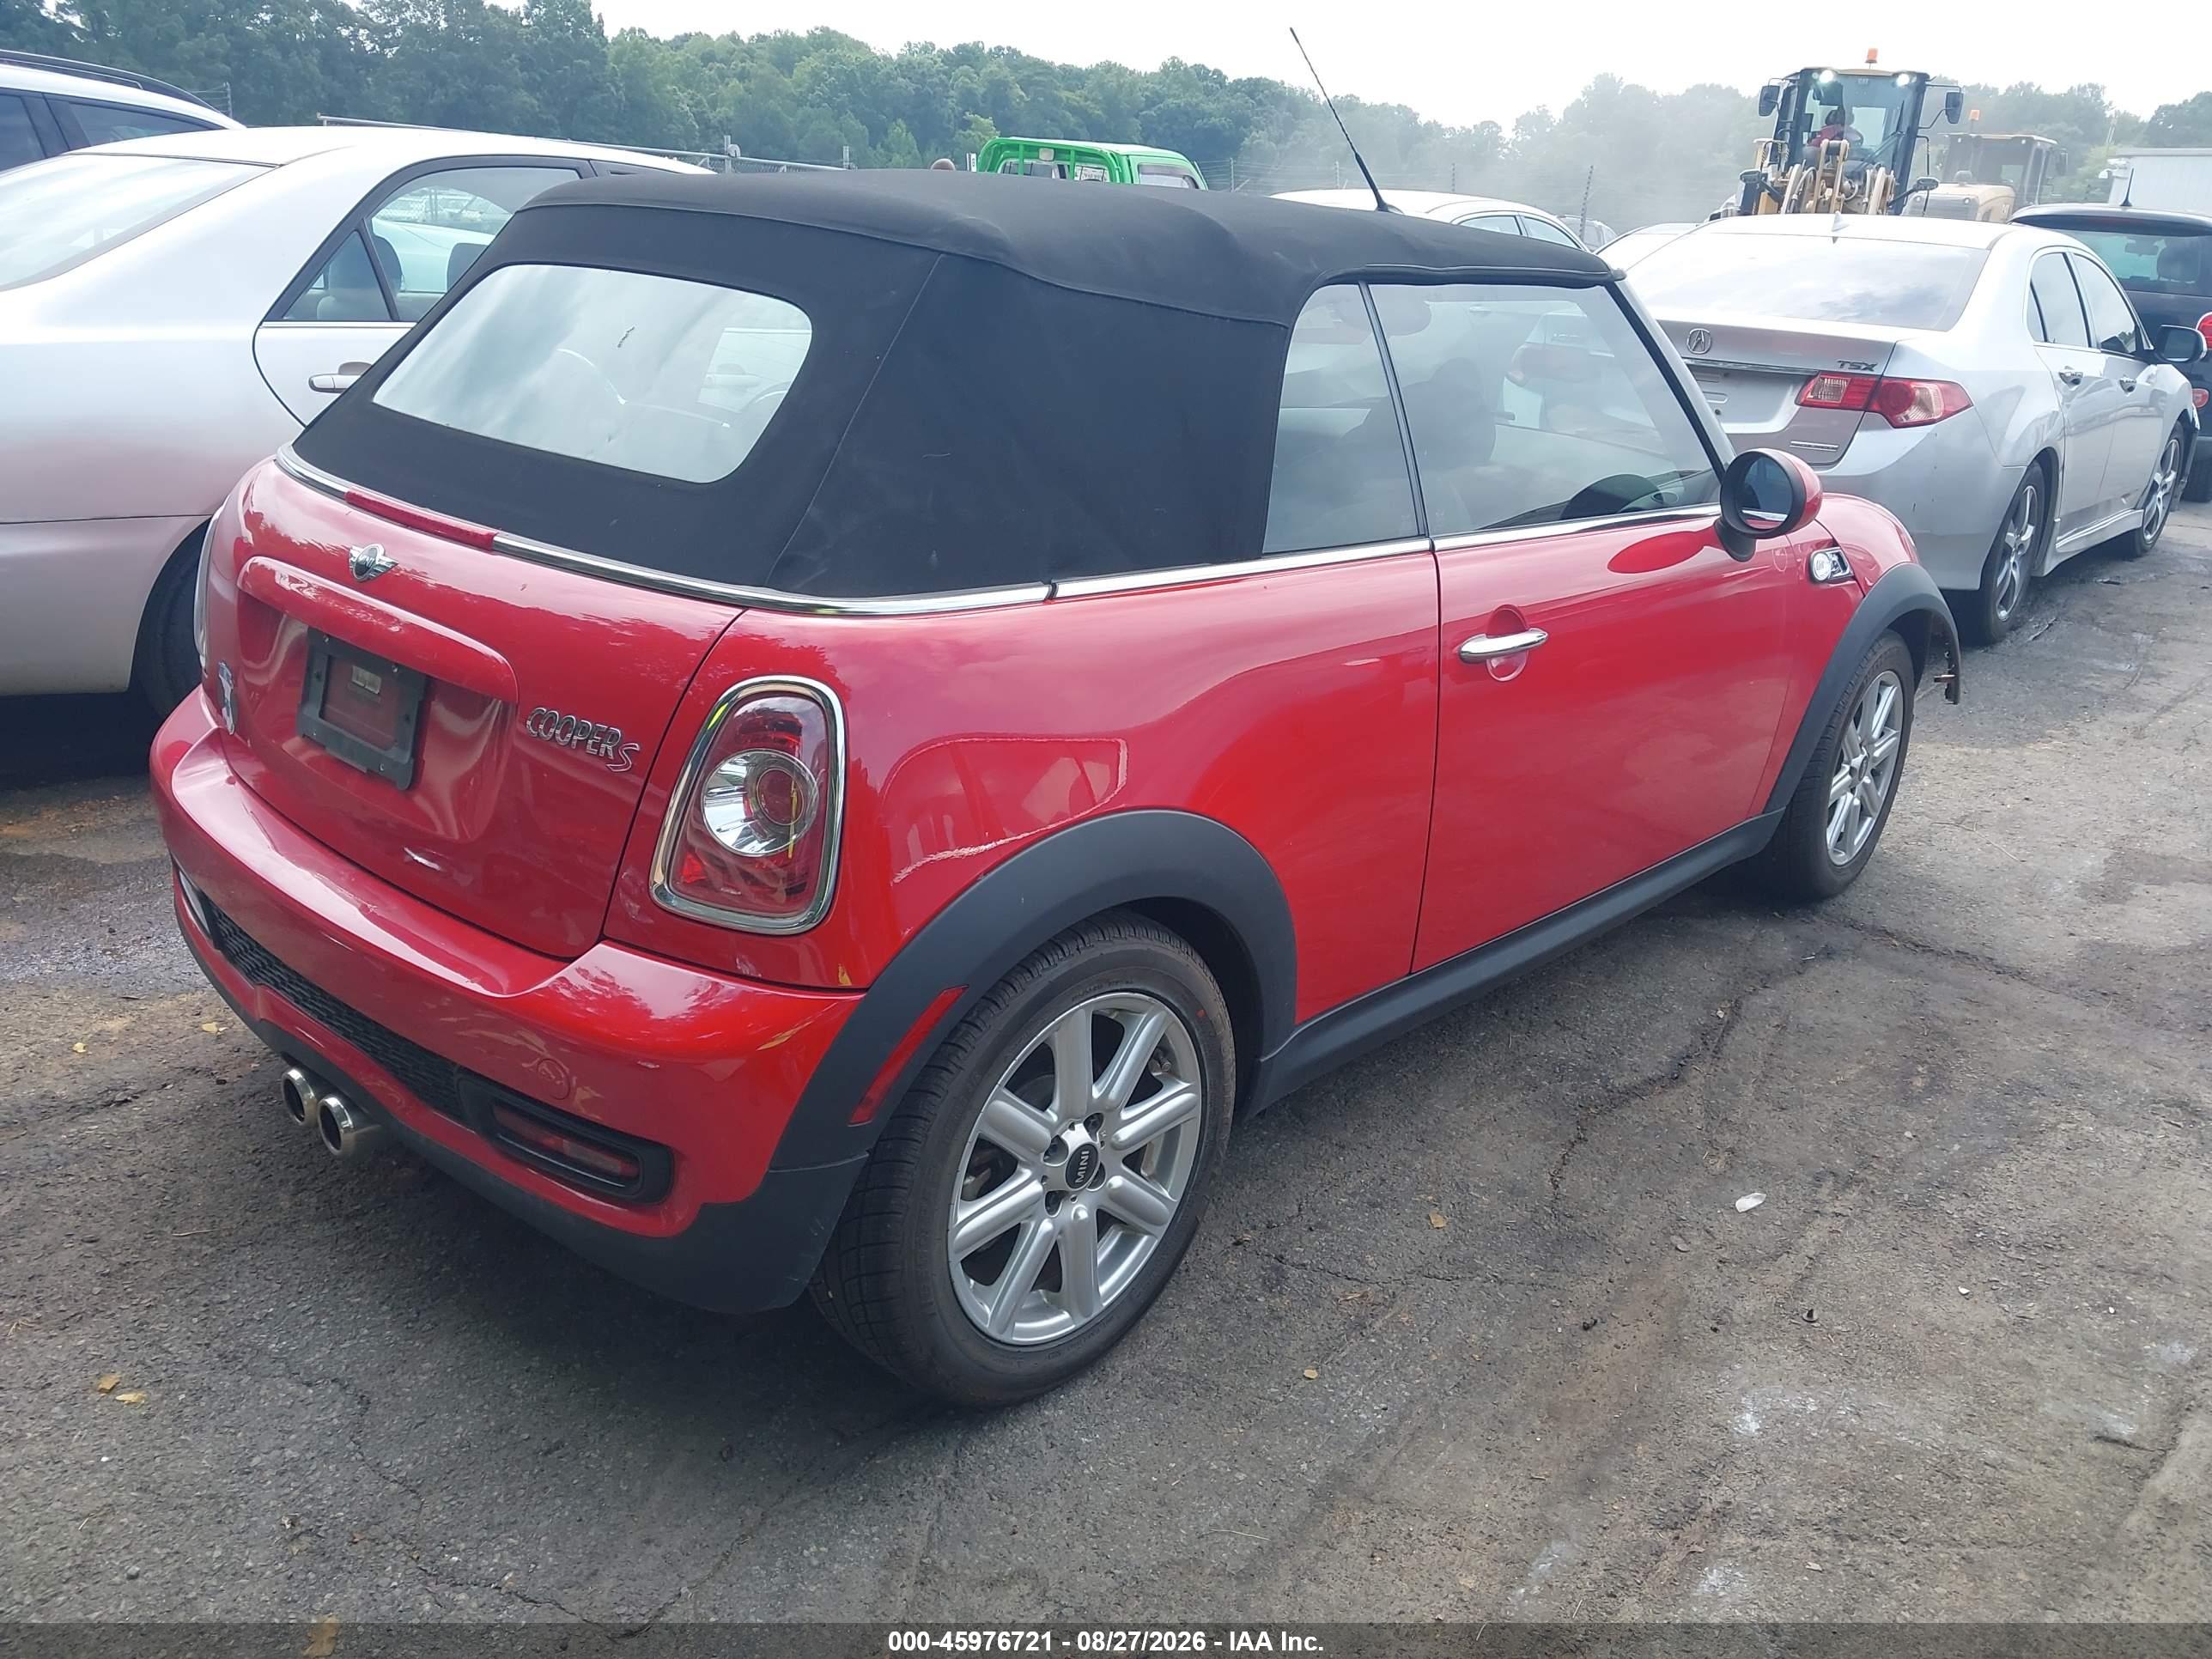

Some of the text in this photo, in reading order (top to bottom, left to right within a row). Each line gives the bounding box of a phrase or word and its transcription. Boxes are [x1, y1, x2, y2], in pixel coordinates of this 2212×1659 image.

[1837, 360, 1878, 372] TSX
[526, 707, 641, 772] COOPER S
[1075, 1151, 1090, 1183] MINI
